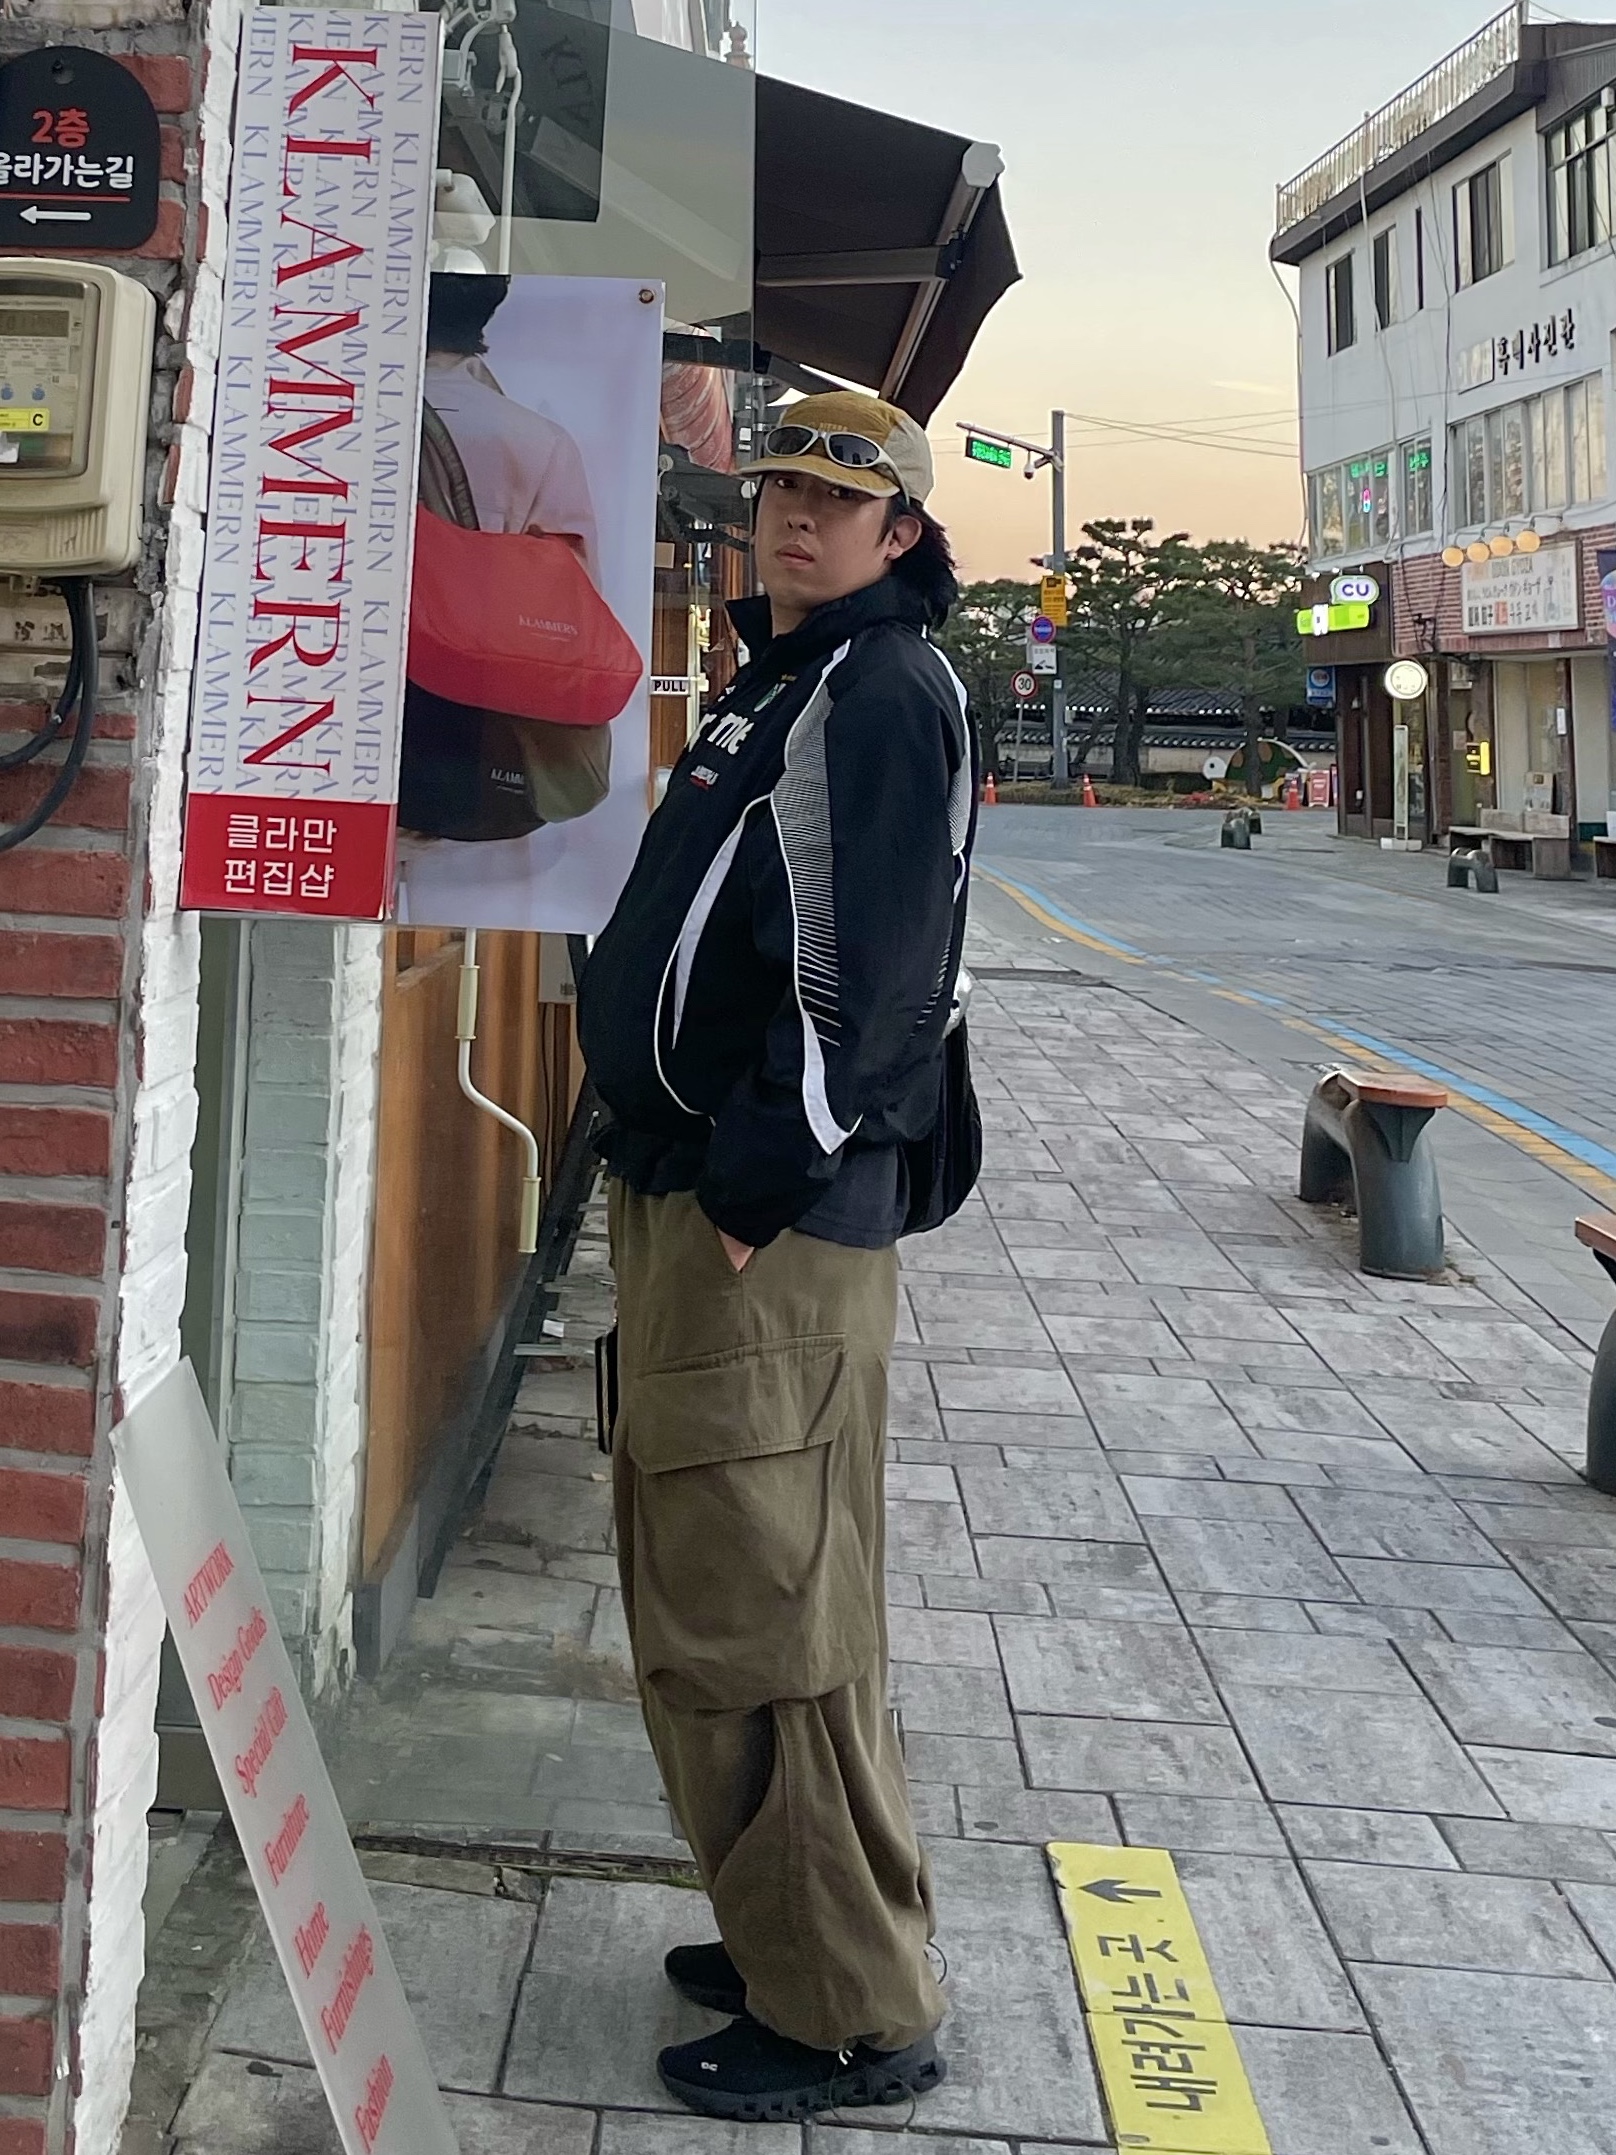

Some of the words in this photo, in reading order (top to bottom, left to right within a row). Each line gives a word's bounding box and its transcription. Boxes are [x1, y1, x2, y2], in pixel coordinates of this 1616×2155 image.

[31, 107, 91, 148] 2층
[231, 125, 270, 329] KLAMMERN
[381, 132, 419, 335] KLAMMERN
[32, 413, 44, 427] C
[243, 43, 377, 776] KLAMMERN
[213, 355, 253, 565] KLAMMERN
[366, 363, 405, 572] KLAMMERN
[1341, 583, 1370, 597] CU
[653, 680, 686, 693] PULL
[1019, 677, 1032, 691] 30
[226, 812, 338, 854] 클라만
[223, 859, 336, 899] 편집샵
[184, 1539, 235, 1629] ARTWORK
[207, 1649, 244, 1711] Design
[235, 1713, 273, 1799] Special
[264, 1793, 309, 1887] Furniture
[294, 1902, 330, 1979] Home
[320, 1923, 375, 2055] Furnishings
[355, 2054, 394, 2154] Fashion
